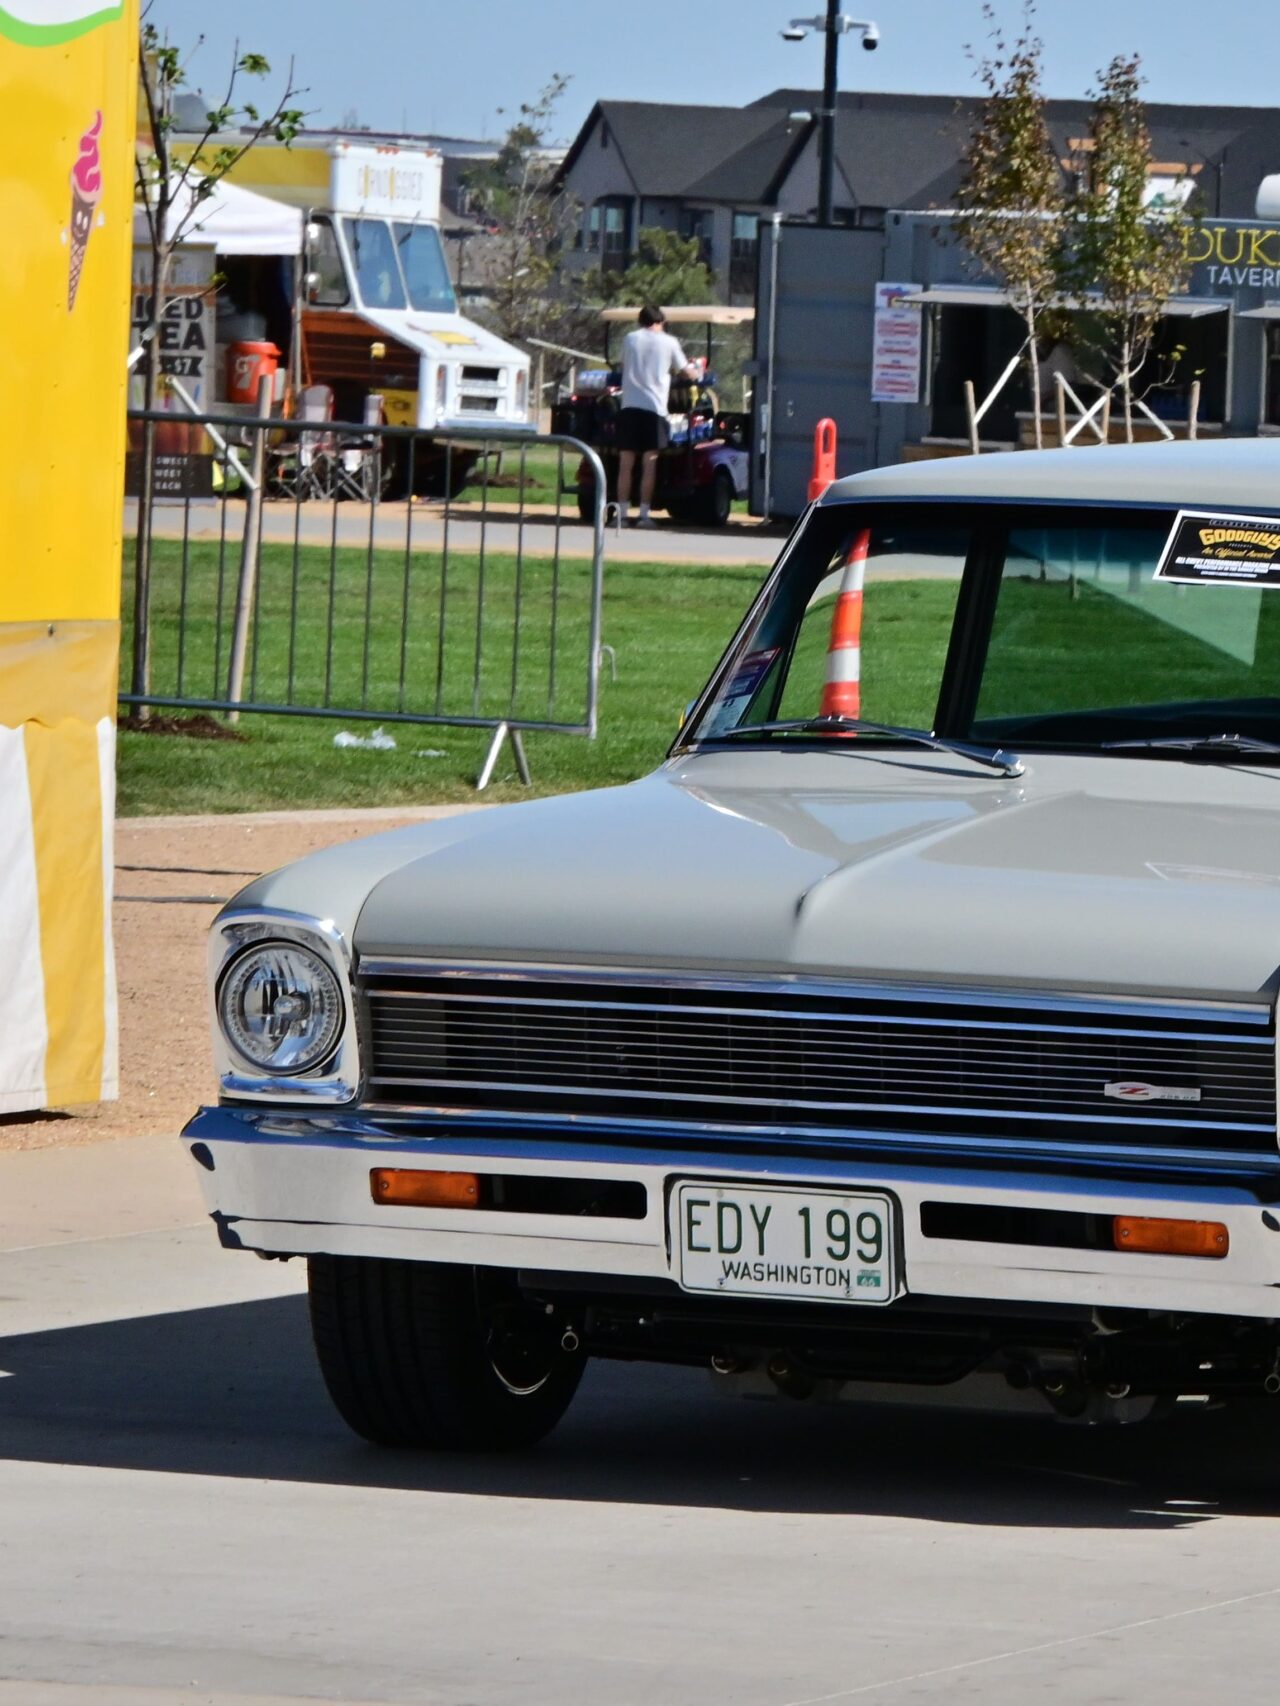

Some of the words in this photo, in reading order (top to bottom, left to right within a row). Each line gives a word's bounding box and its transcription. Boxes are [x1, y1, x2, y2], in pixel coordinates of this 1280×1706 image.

[686, 1199, 772, 1256] EDY
[798, 1206, 882, 1264] 199
[722, 1260, 851, 1288] WASHINGTON
